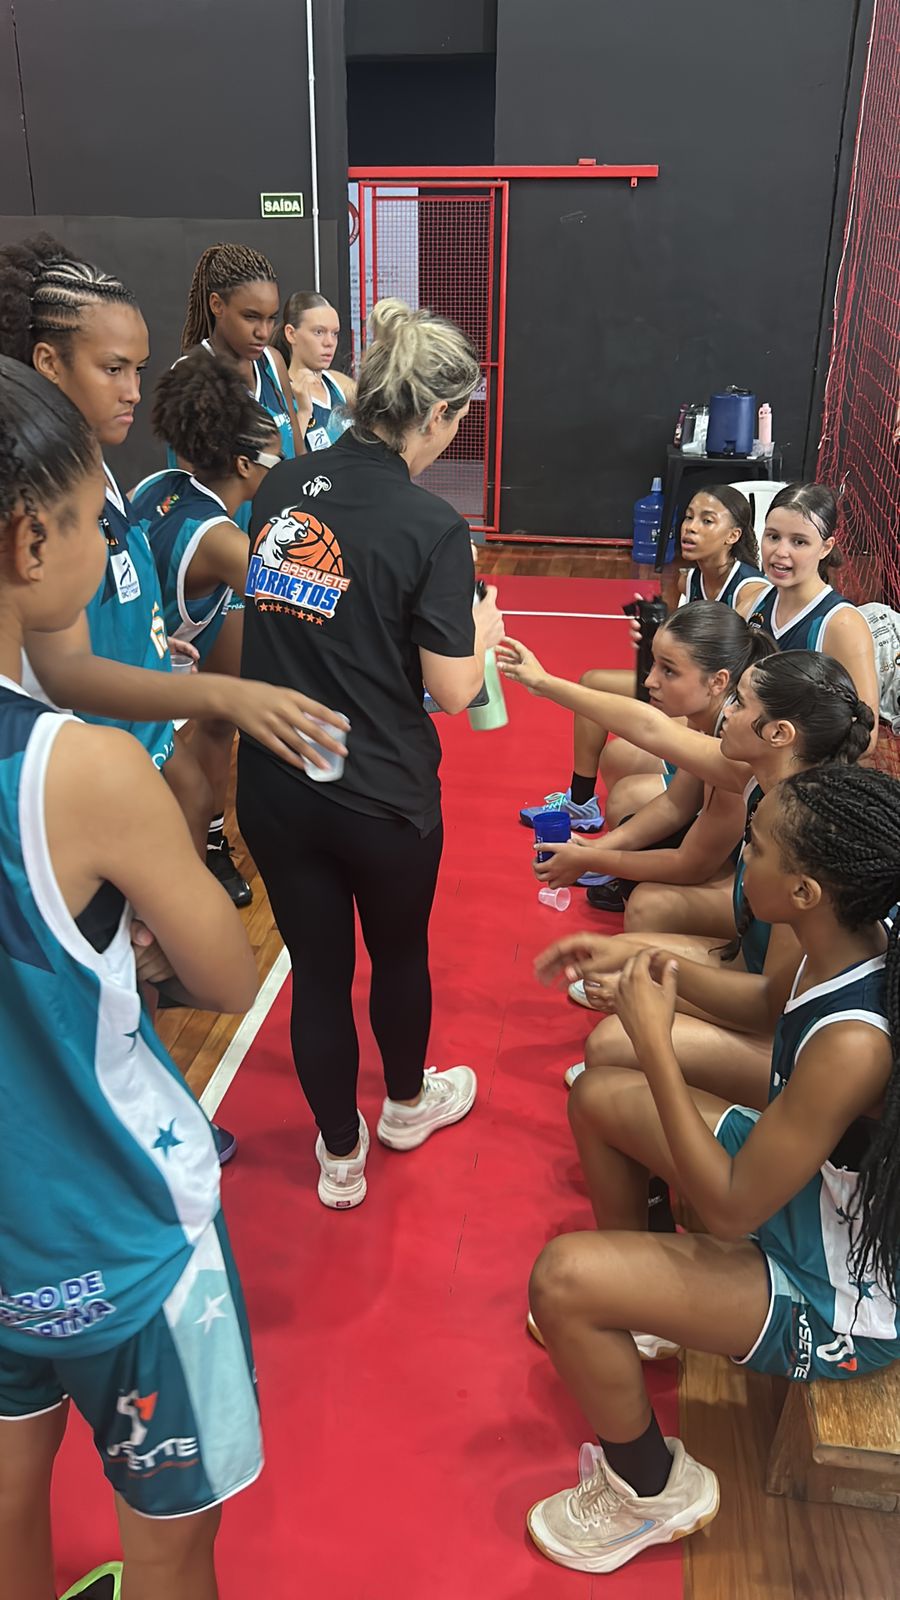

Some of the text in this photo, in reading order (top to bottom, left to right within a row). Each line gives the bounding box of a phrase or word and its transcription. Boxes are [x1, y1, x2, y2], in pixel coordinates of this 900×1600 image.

[264, 198, 301, 212] SAÍDA
[245, 554, 341, 612] BARRETOS
[280, 560, 350, 591] BASQUETE
[60, 1270, 106, 1301] DE
